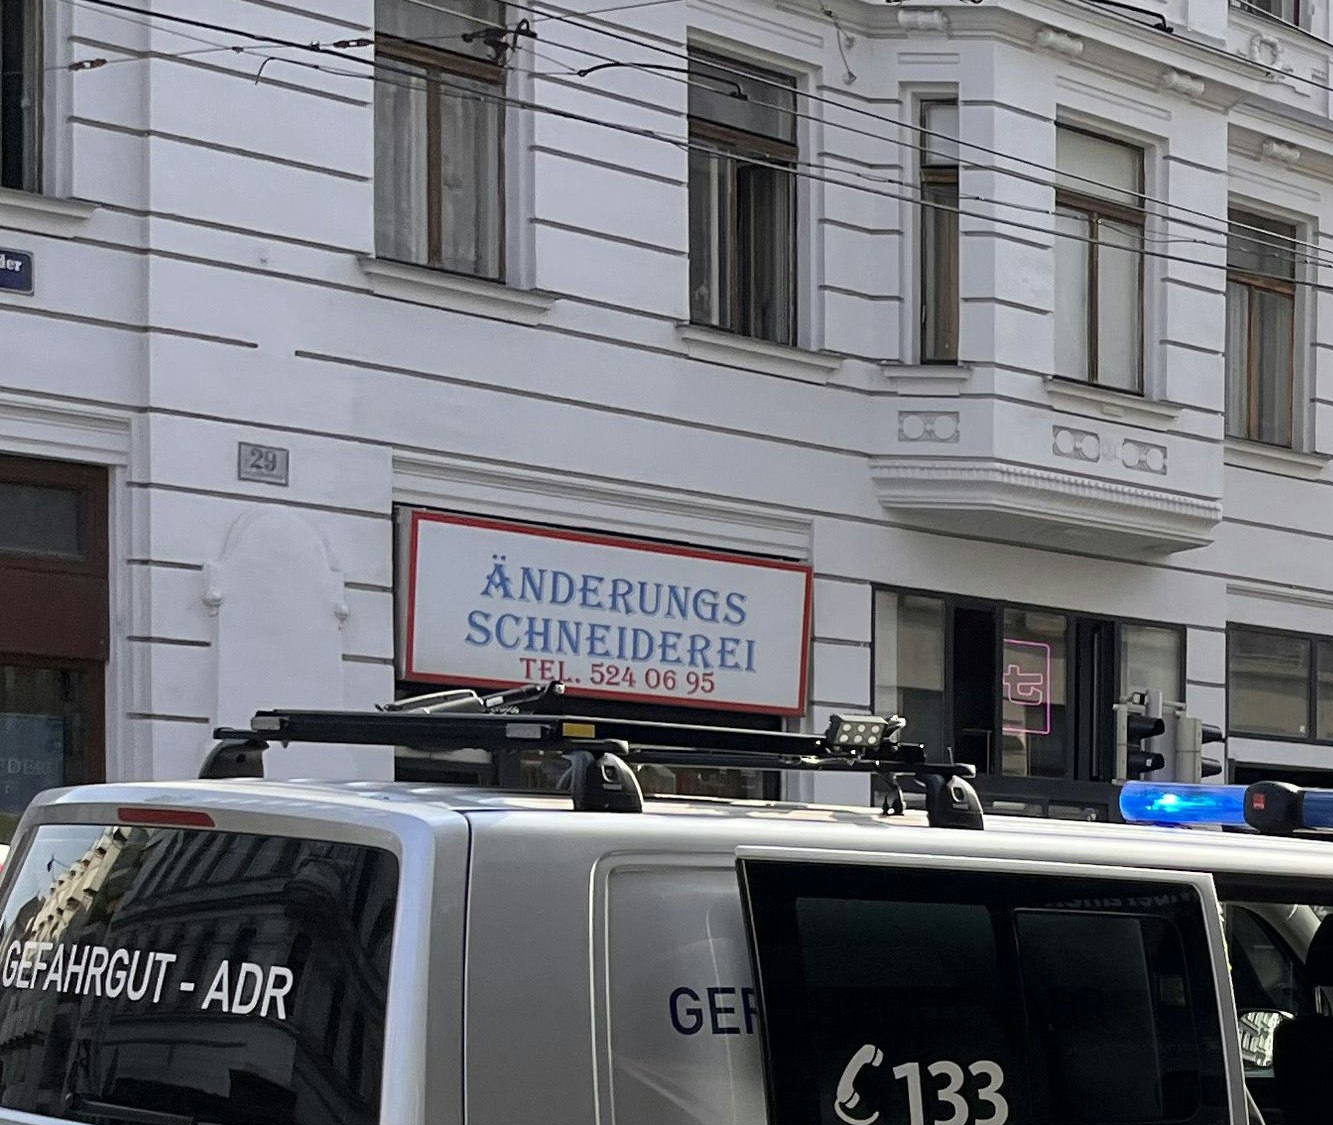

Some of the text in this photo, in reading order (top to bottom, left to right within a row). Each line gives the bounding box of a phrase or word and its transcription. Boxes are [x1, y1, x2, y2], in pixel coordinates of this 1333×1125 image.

[250, 448, 277, 471] 29
[480, 553, 749, 626] ÄNDERUNGS
[464, 609, 758, 674] SCHNEIDEREI
[519, 657, 716, 695] TEL. 524 06 95
[2, 940, 177, 1005] GEFAHRGUT
[201, 959, 295, 1021] ADR
